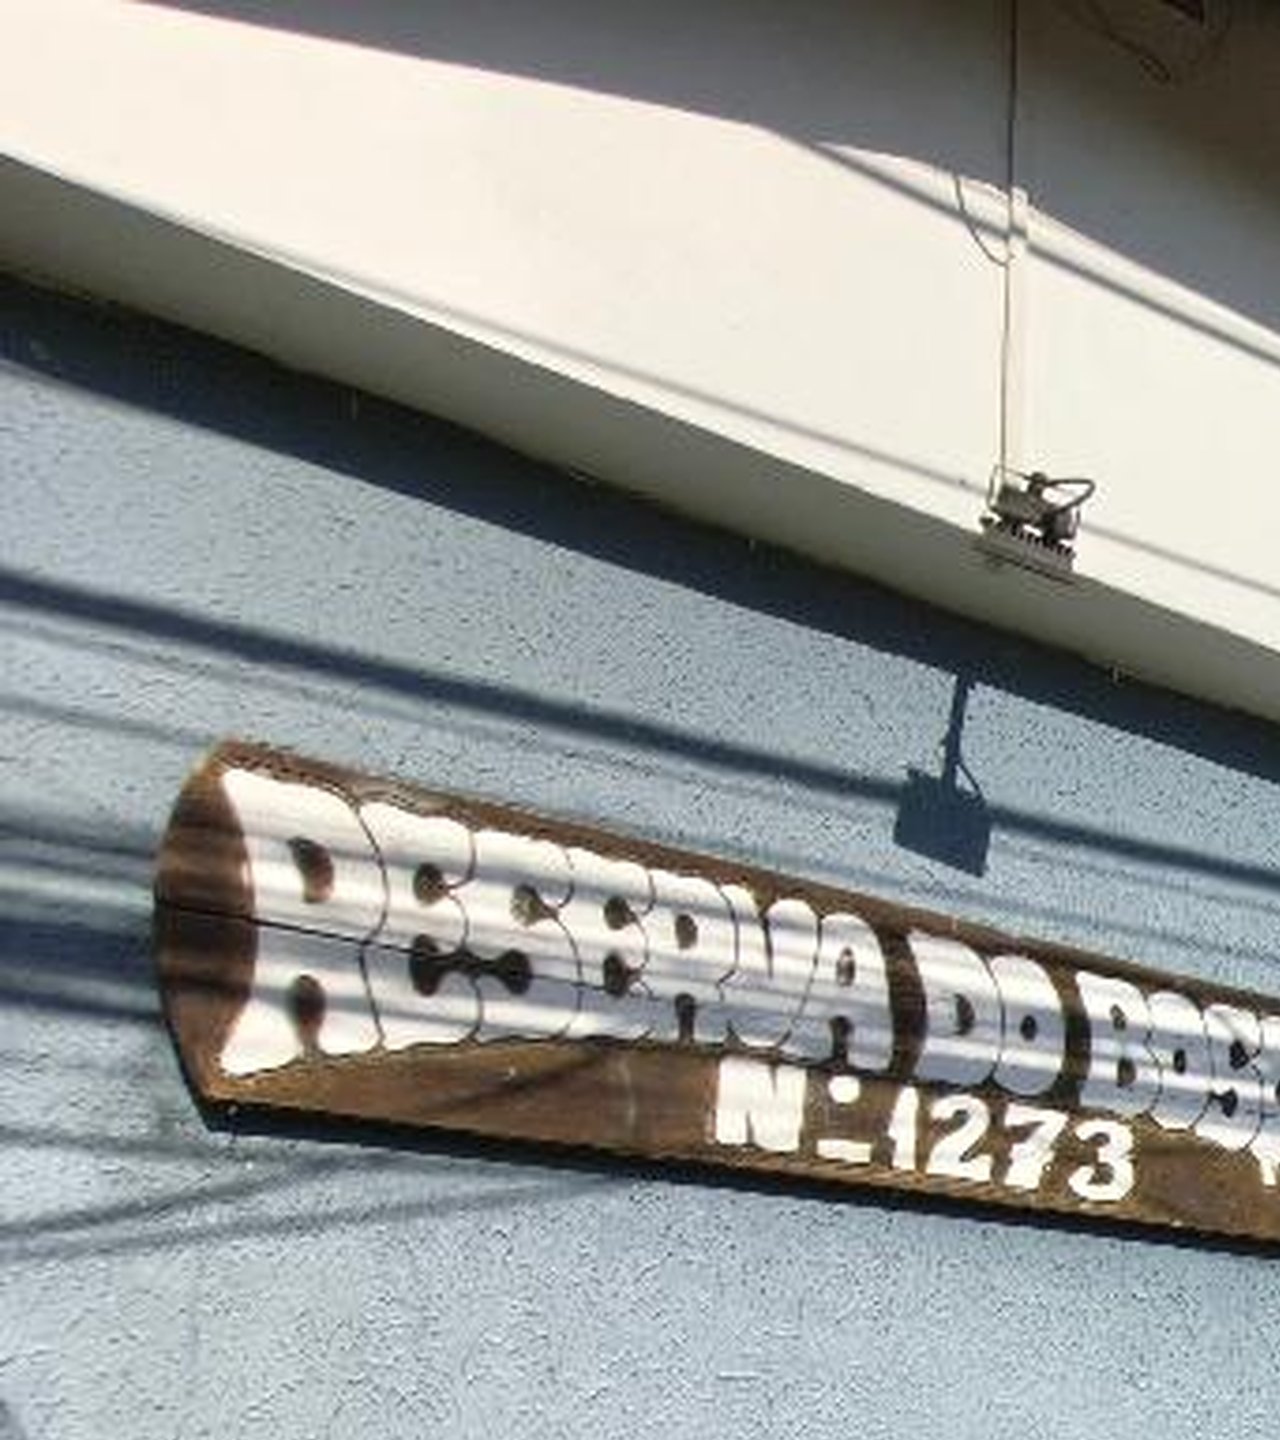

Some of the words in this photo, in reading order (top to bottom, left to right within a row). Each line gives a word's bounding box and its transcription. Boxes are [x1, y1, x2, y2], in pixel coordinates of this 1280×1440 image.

[220, 768, 894, 1077] RESERVA
[907, 930, 1065, 1098] DO
[887, 1085, 1135, 1202] 1273
